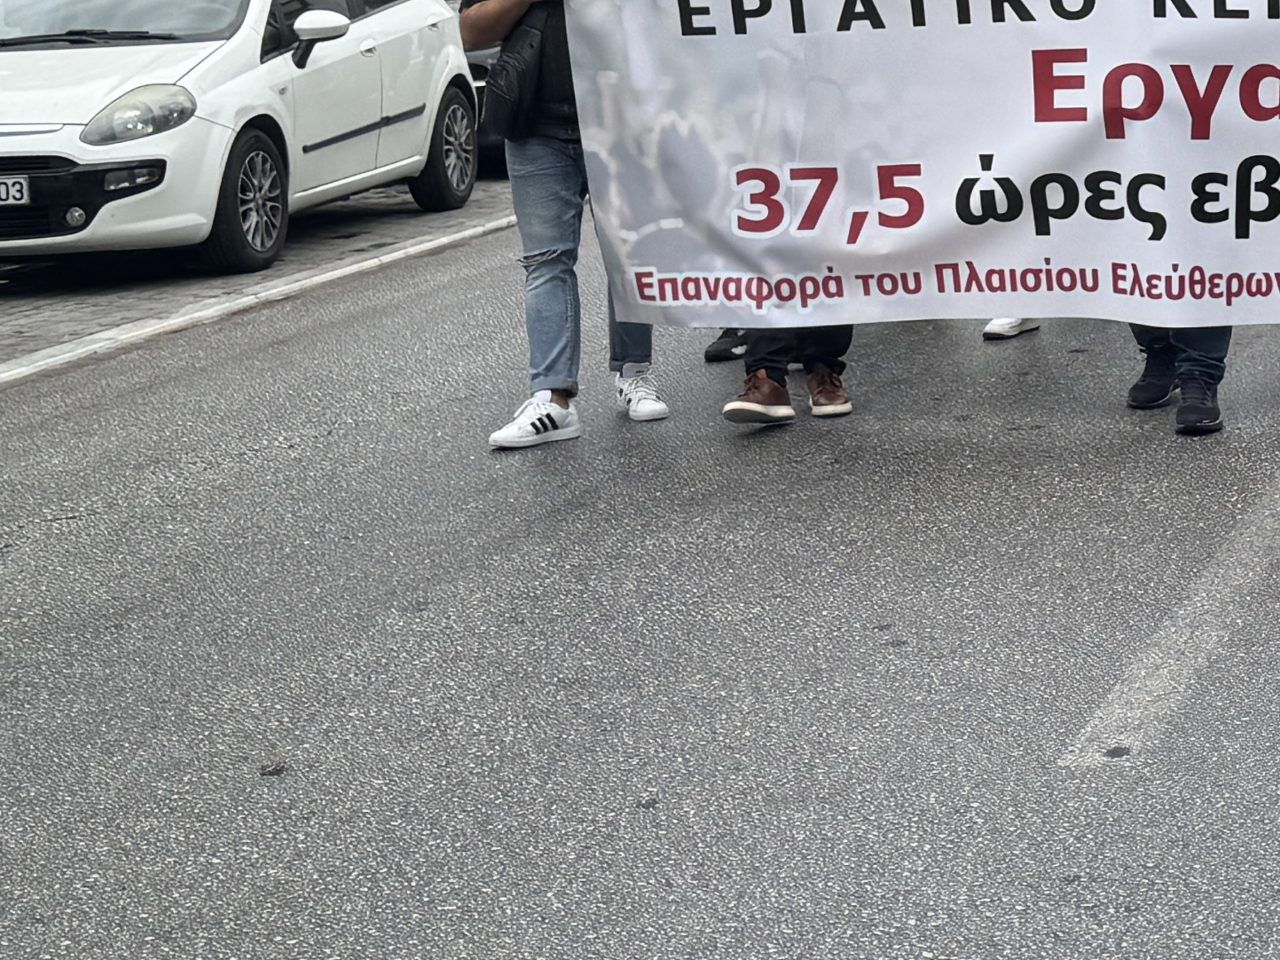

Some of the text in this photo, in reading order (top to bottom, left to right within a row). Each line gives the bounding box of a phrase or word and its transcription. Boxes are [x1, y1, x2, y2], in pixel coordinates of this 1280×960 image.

[734, 163, 926, 245] 37,5
[954, 153, 1168, 241] ώρες
[634, 266, 845, 310] Επαναφορά
[855, 271, 923, 297] του
[935, 257, 1100, 294] Πλαισίου
